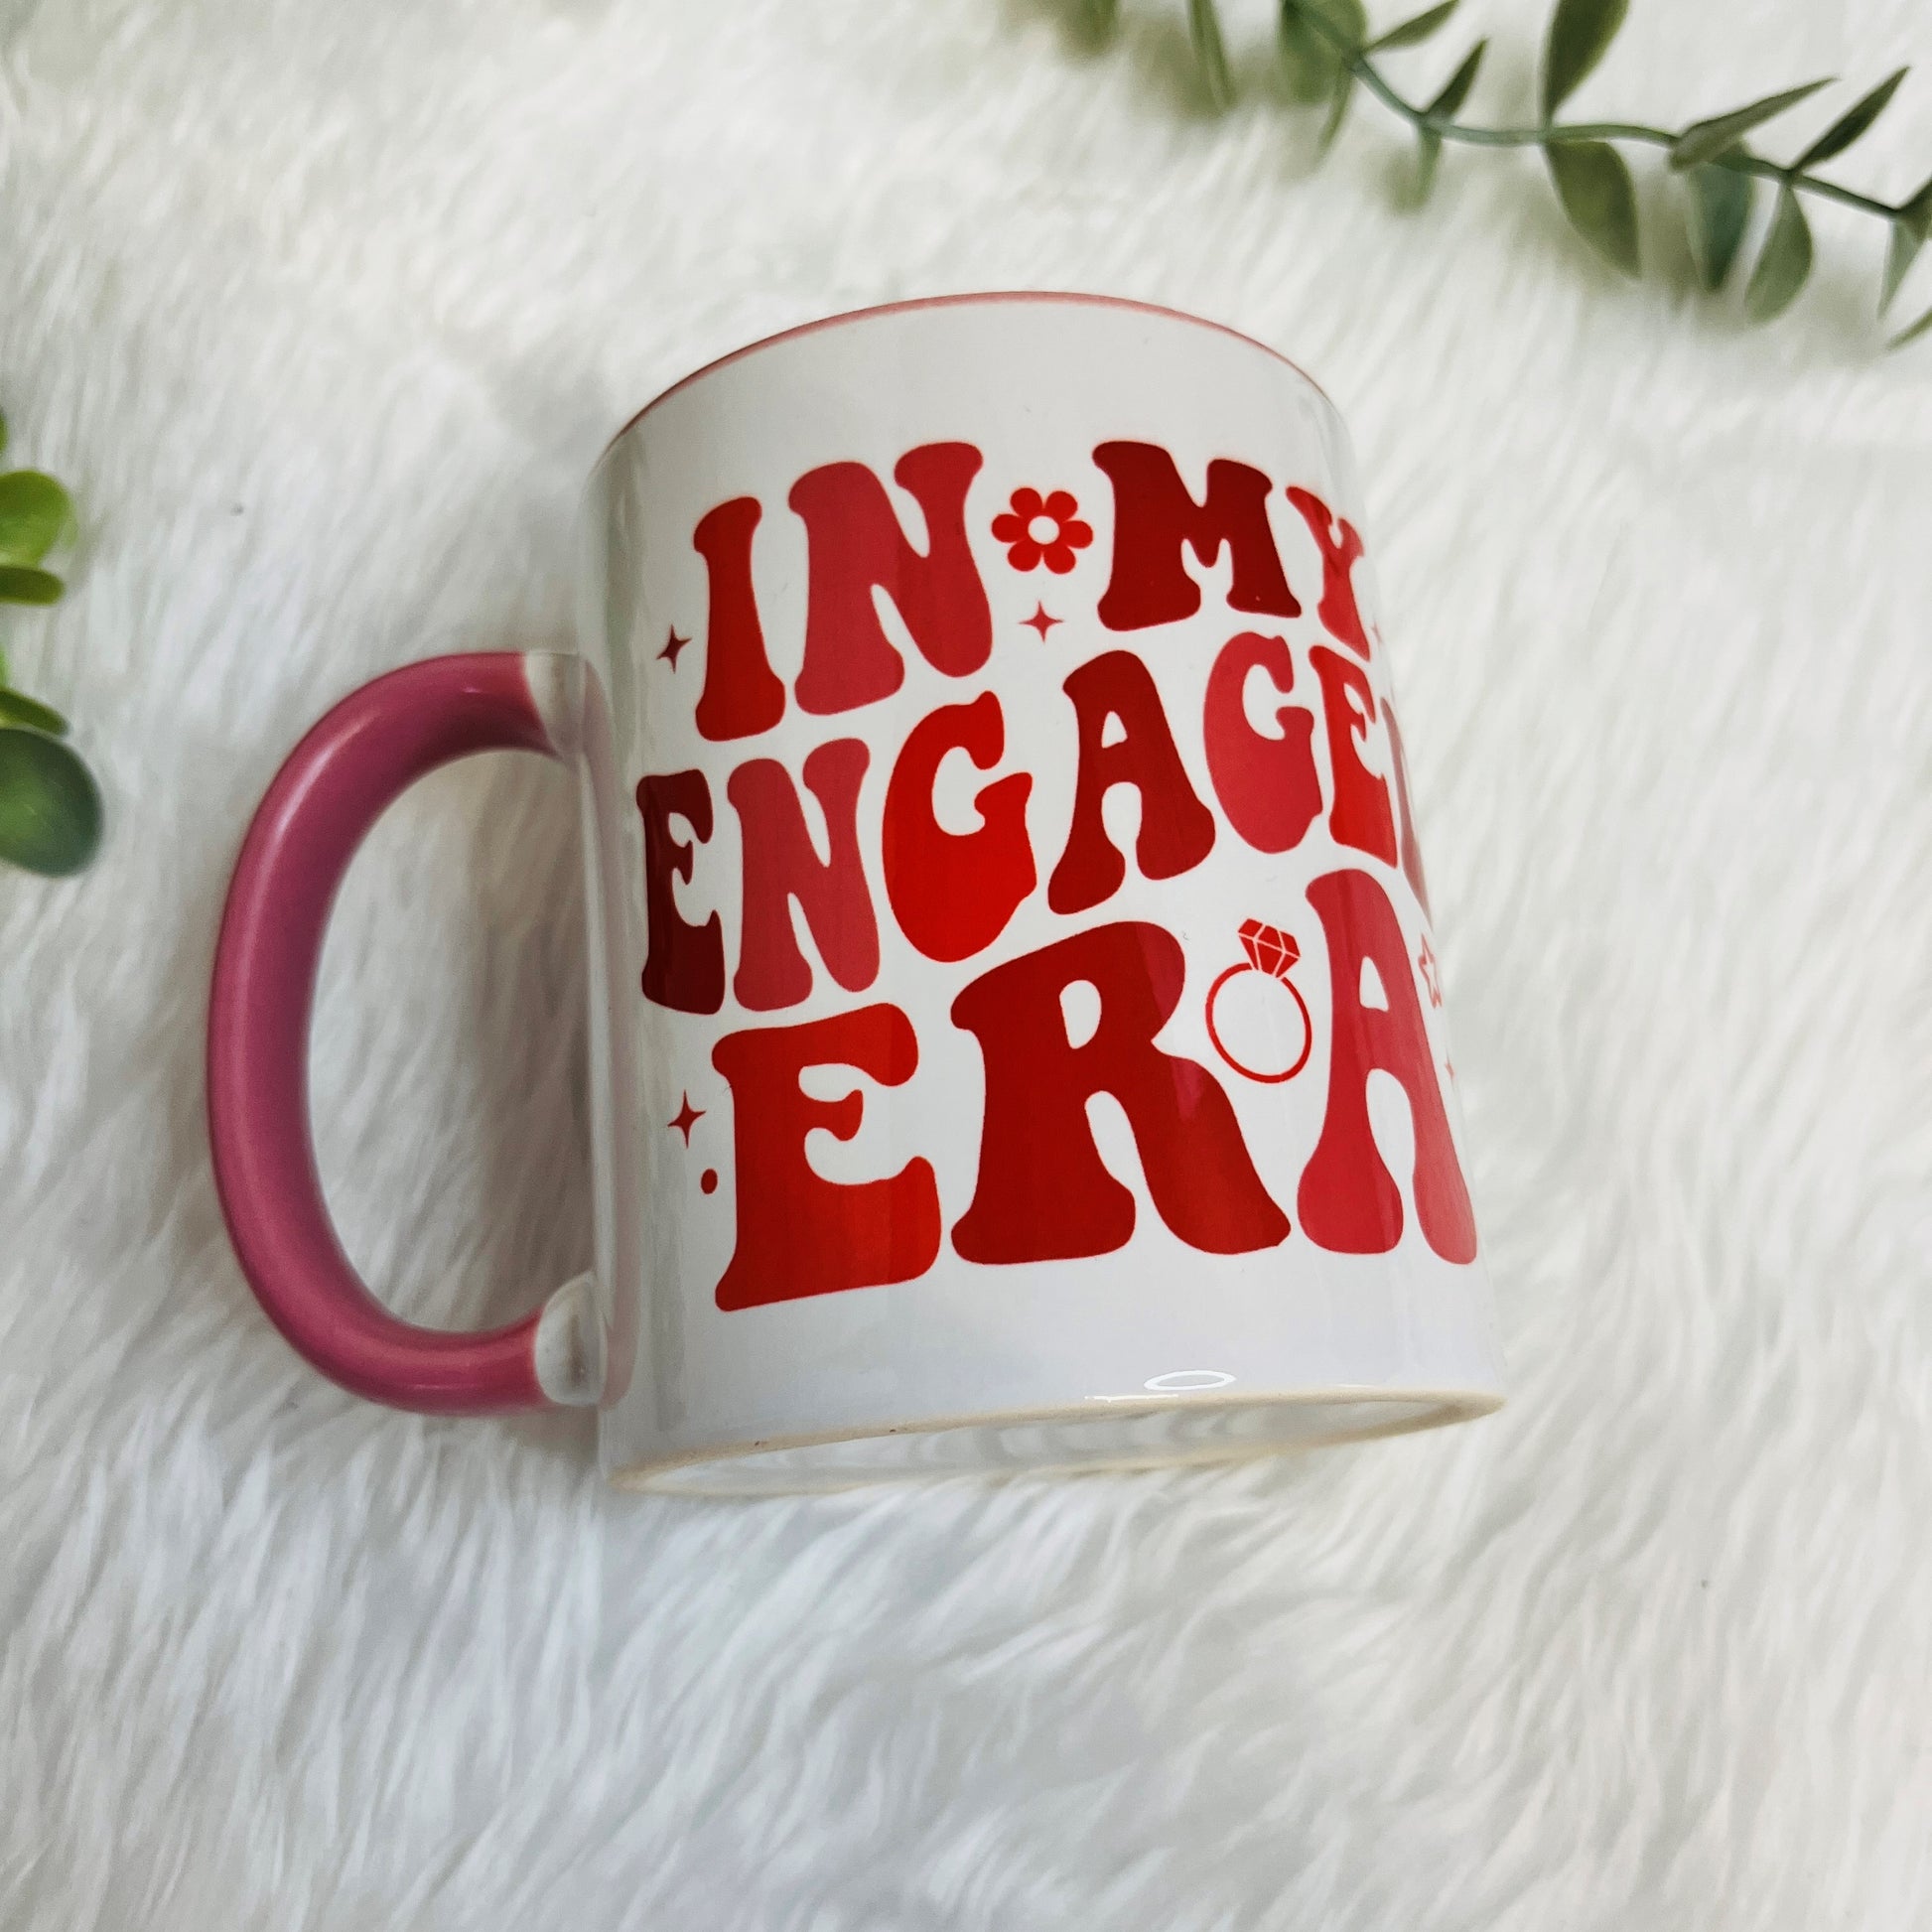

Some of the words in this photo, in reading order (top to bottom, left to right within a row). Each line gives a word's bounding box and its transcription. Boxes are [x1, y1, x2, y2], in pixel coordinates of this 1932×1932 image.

[693, 441, 993, 742] IN
[1092, 440, 1370, 662] MY
[636, 631, 1432, 1015] ENGAGE
[712, 869, 1476, 1312] ERA
